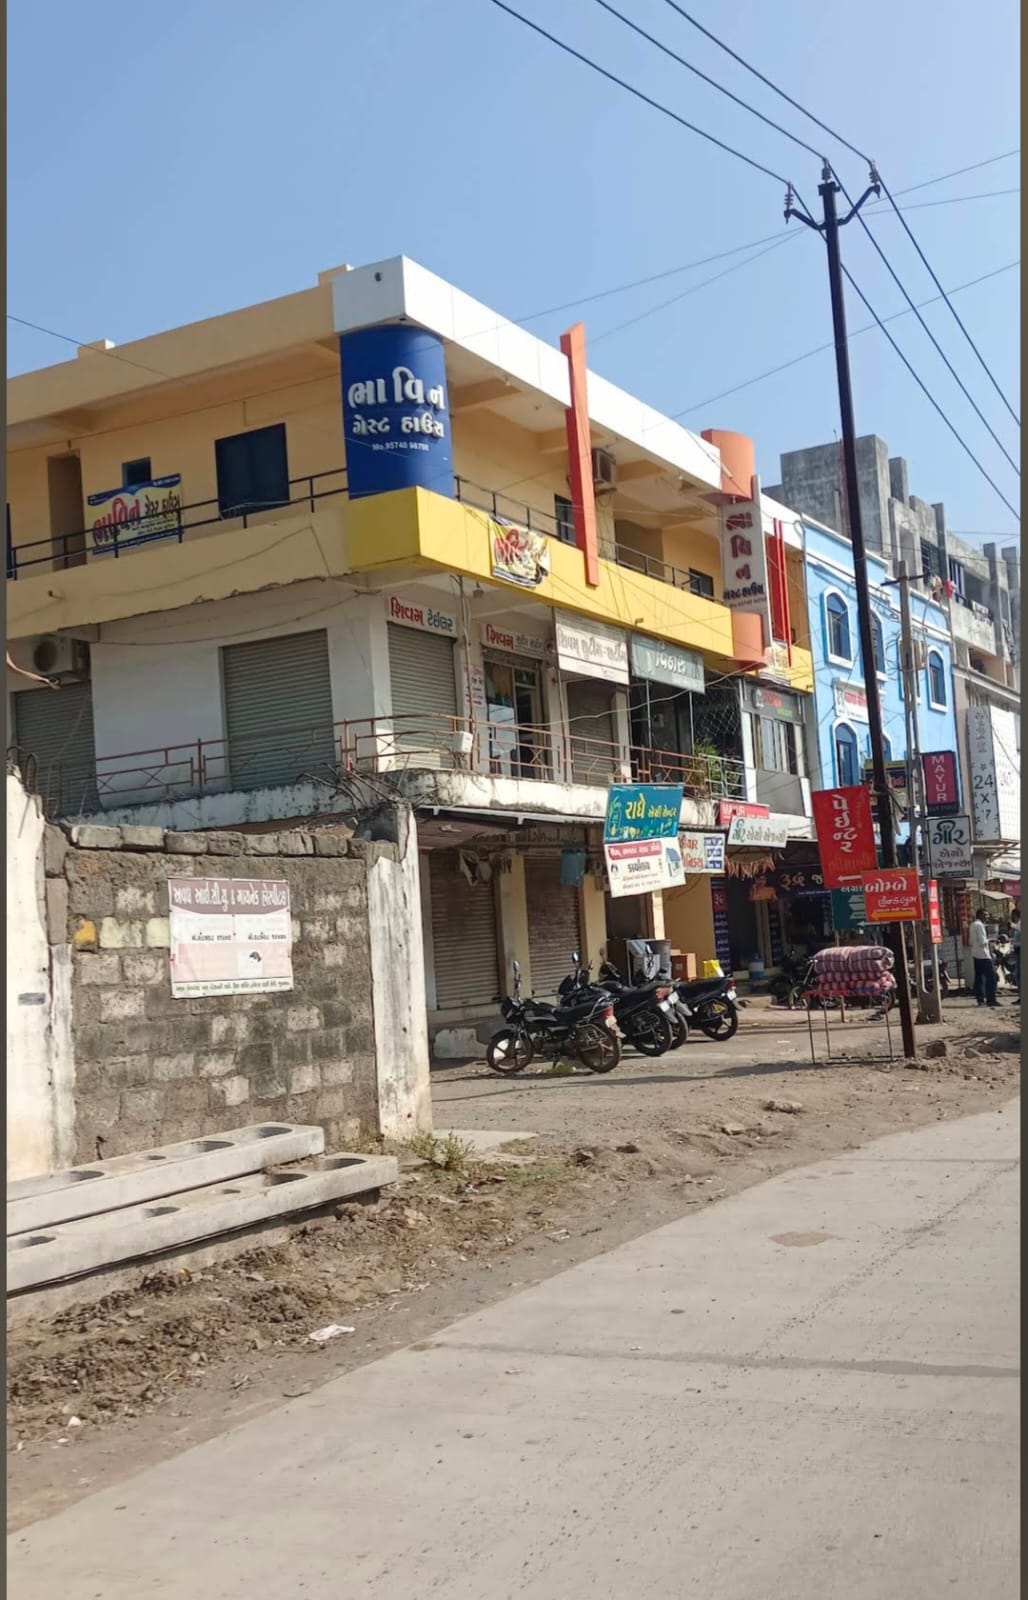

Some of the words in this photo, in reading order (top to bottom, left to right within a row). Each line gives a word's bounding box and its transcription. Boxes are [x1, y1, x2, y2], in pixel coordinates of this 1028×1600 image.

[347, 366, 445, 410] ભાવિન
[353, 414, 390, 435] ગેસ્ટ
[390, 597, 424, 626] શિવમ
[932, 755, 948, 802] MAYUR
[974, 774, 994, 790] 24
[625, 793, 646, 819] રાધે
[932, 820, 969, 846] ગીર
[864, 876, 908, 894] બોમ્બે
